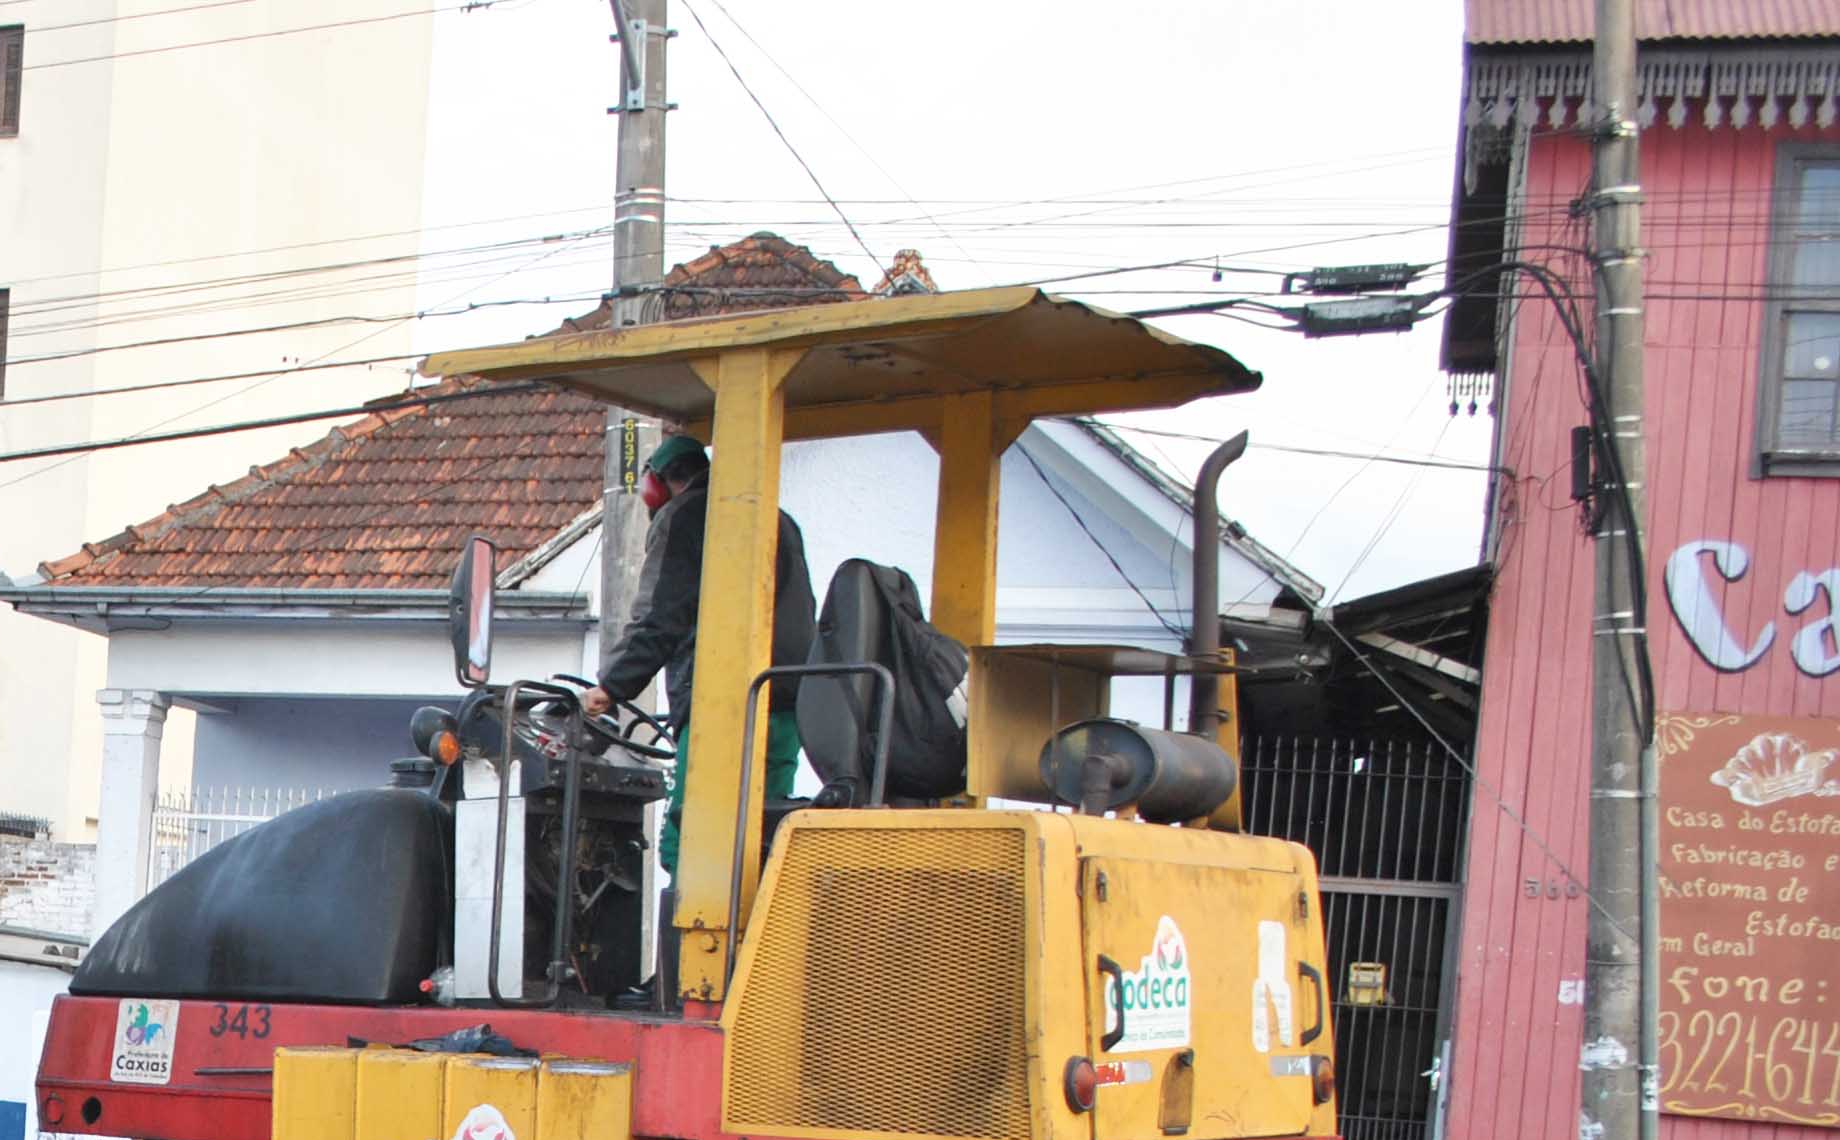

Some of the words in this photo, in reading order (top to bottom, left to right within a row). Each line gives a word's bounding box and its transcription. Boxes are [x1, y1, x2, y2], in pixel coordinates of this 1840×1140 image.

[1667, 806, 1725, 829] Casa
[1737, 810, 1766, 831] do
[1824, 854, 1840, 872] e
[1777, 877, 1809, 903] de
[1658, 936, 1683, 953] m
[1693, 932, 1756, 956] Geral
[211, 1005, 272, 1040] 343
[116, 1055, 167, 1072] Caxias
